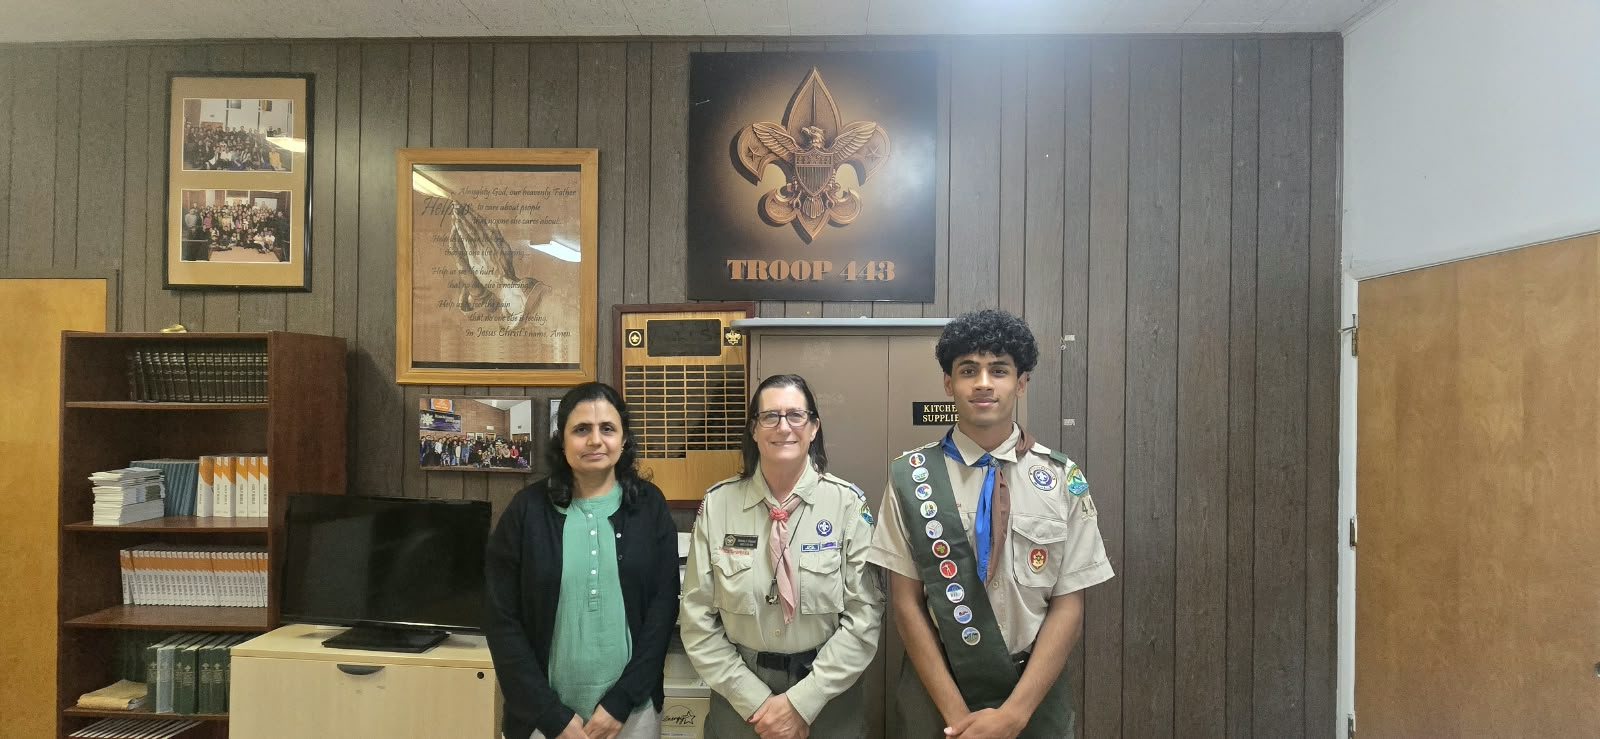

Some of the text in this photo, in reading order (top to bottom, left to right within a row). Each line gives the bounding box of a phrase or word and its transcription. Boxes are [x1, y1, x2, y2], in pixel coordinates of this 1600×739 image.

[522, 186, 551, 200] heavenly
[500, 202, 519, 211] about
[520, 202, 541, 215] people
[726, 259, 896, 281] TROOP 443
[476, 326, 497, 338] Jesus
[923, 404, 958, 413] KITCHE
[922, 414, 960, 423] SUPPLIE
